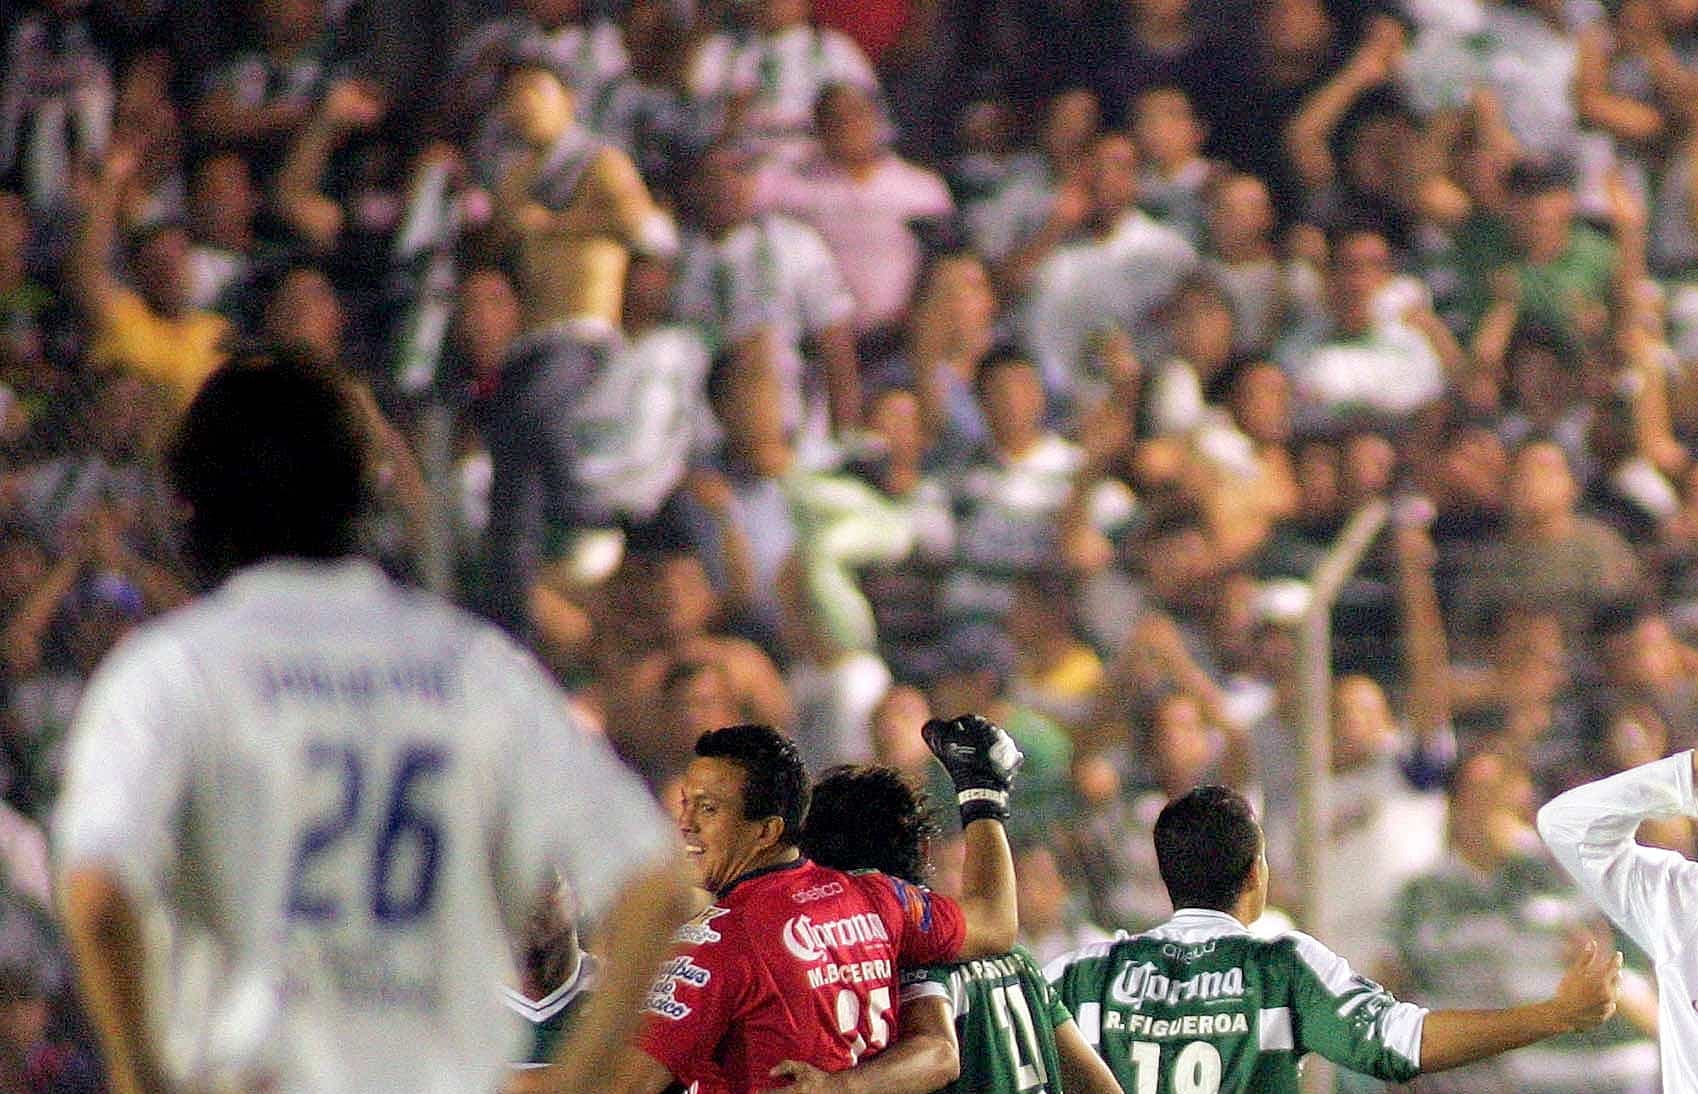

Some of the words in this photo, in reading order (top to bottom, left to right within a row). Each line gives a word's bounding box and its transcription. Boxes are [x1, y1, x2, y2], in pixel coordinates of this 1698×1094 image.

[283, 742, 449, 922] 26
[1113, 960, 1245, 1009] Corona
[1104, 1010, 1125, 1030] R.
[1130, 1013, 1249, 1038] FIGUEROA
